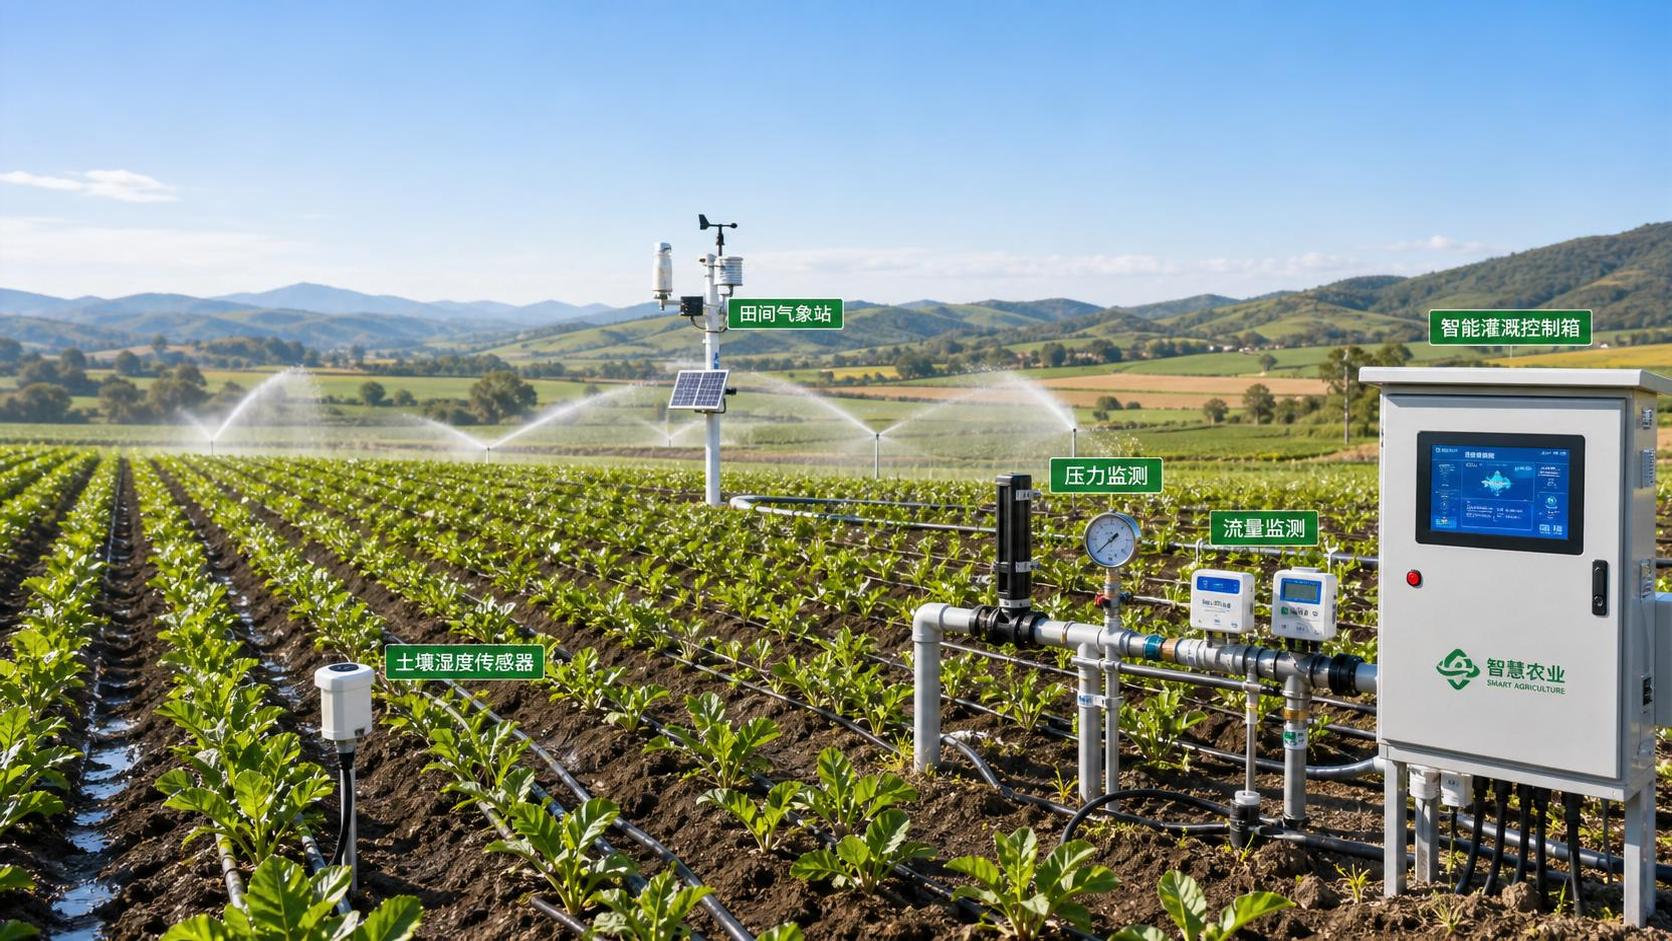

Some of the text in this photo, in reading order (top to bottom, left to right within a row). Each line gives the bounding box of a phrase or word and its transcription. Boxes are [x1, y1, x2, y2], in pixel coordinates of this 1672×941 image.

[740, 304, 832, 323] 田间气象站
[1441, 318, 1581, 338] 智能灌溉控制箱
[1064, 465, 1148, 486] 压力监测
[1223, 518, 1305, 538] 流量监测
[395, 652, 534, 672] 土壤湿度传感器
[1487, 658, 1565, 683] 智慧农业
[1487, 680, 1566, 695] SMART AGRICULTURE
